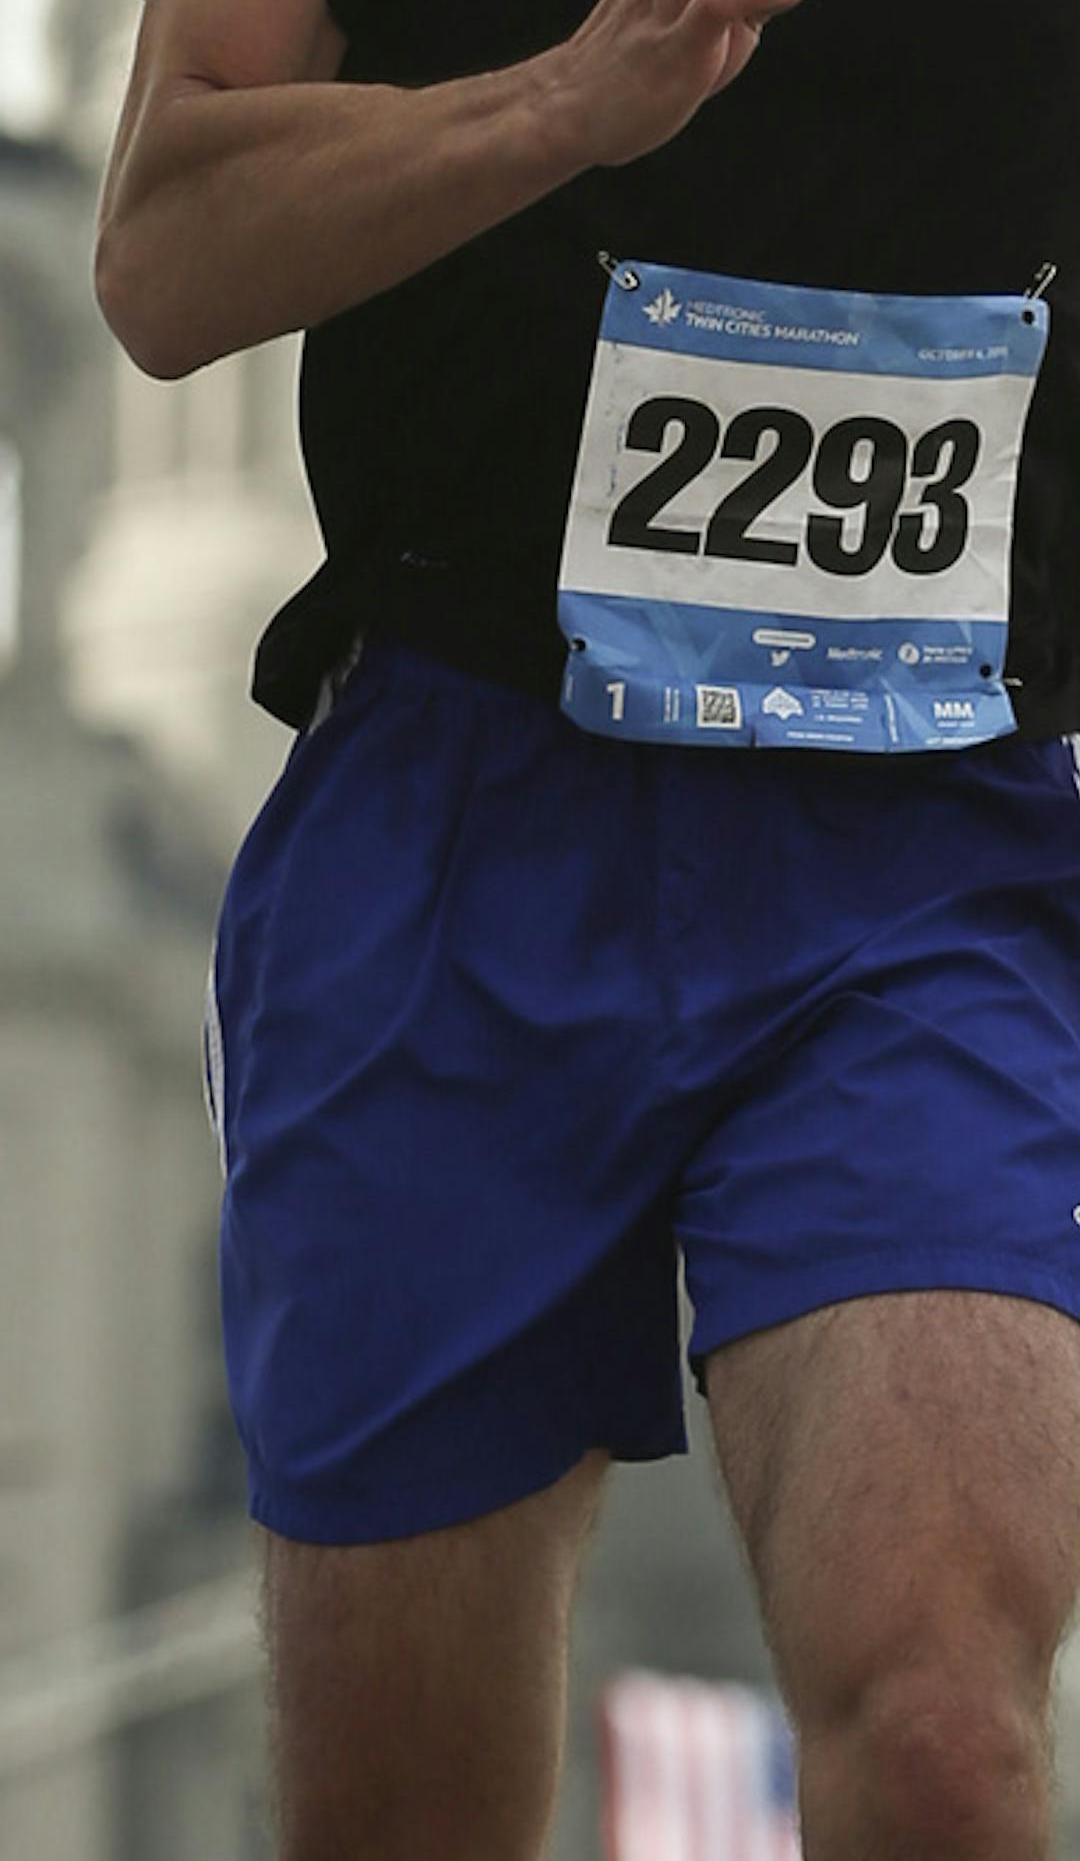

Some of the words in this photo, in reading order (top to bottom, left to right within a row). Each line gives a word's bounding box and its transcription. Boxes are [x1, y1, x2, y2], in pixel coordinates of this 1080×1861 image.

[685, 312, 724, 331] TWIN
[725, 320, 772, 338] CITIES
[773, 326, 860, 346] MARATHON
[608, 397, 980, 575] 2293
[606, 681, 626, 721] 1
[933, 700, 975, 719] MM
